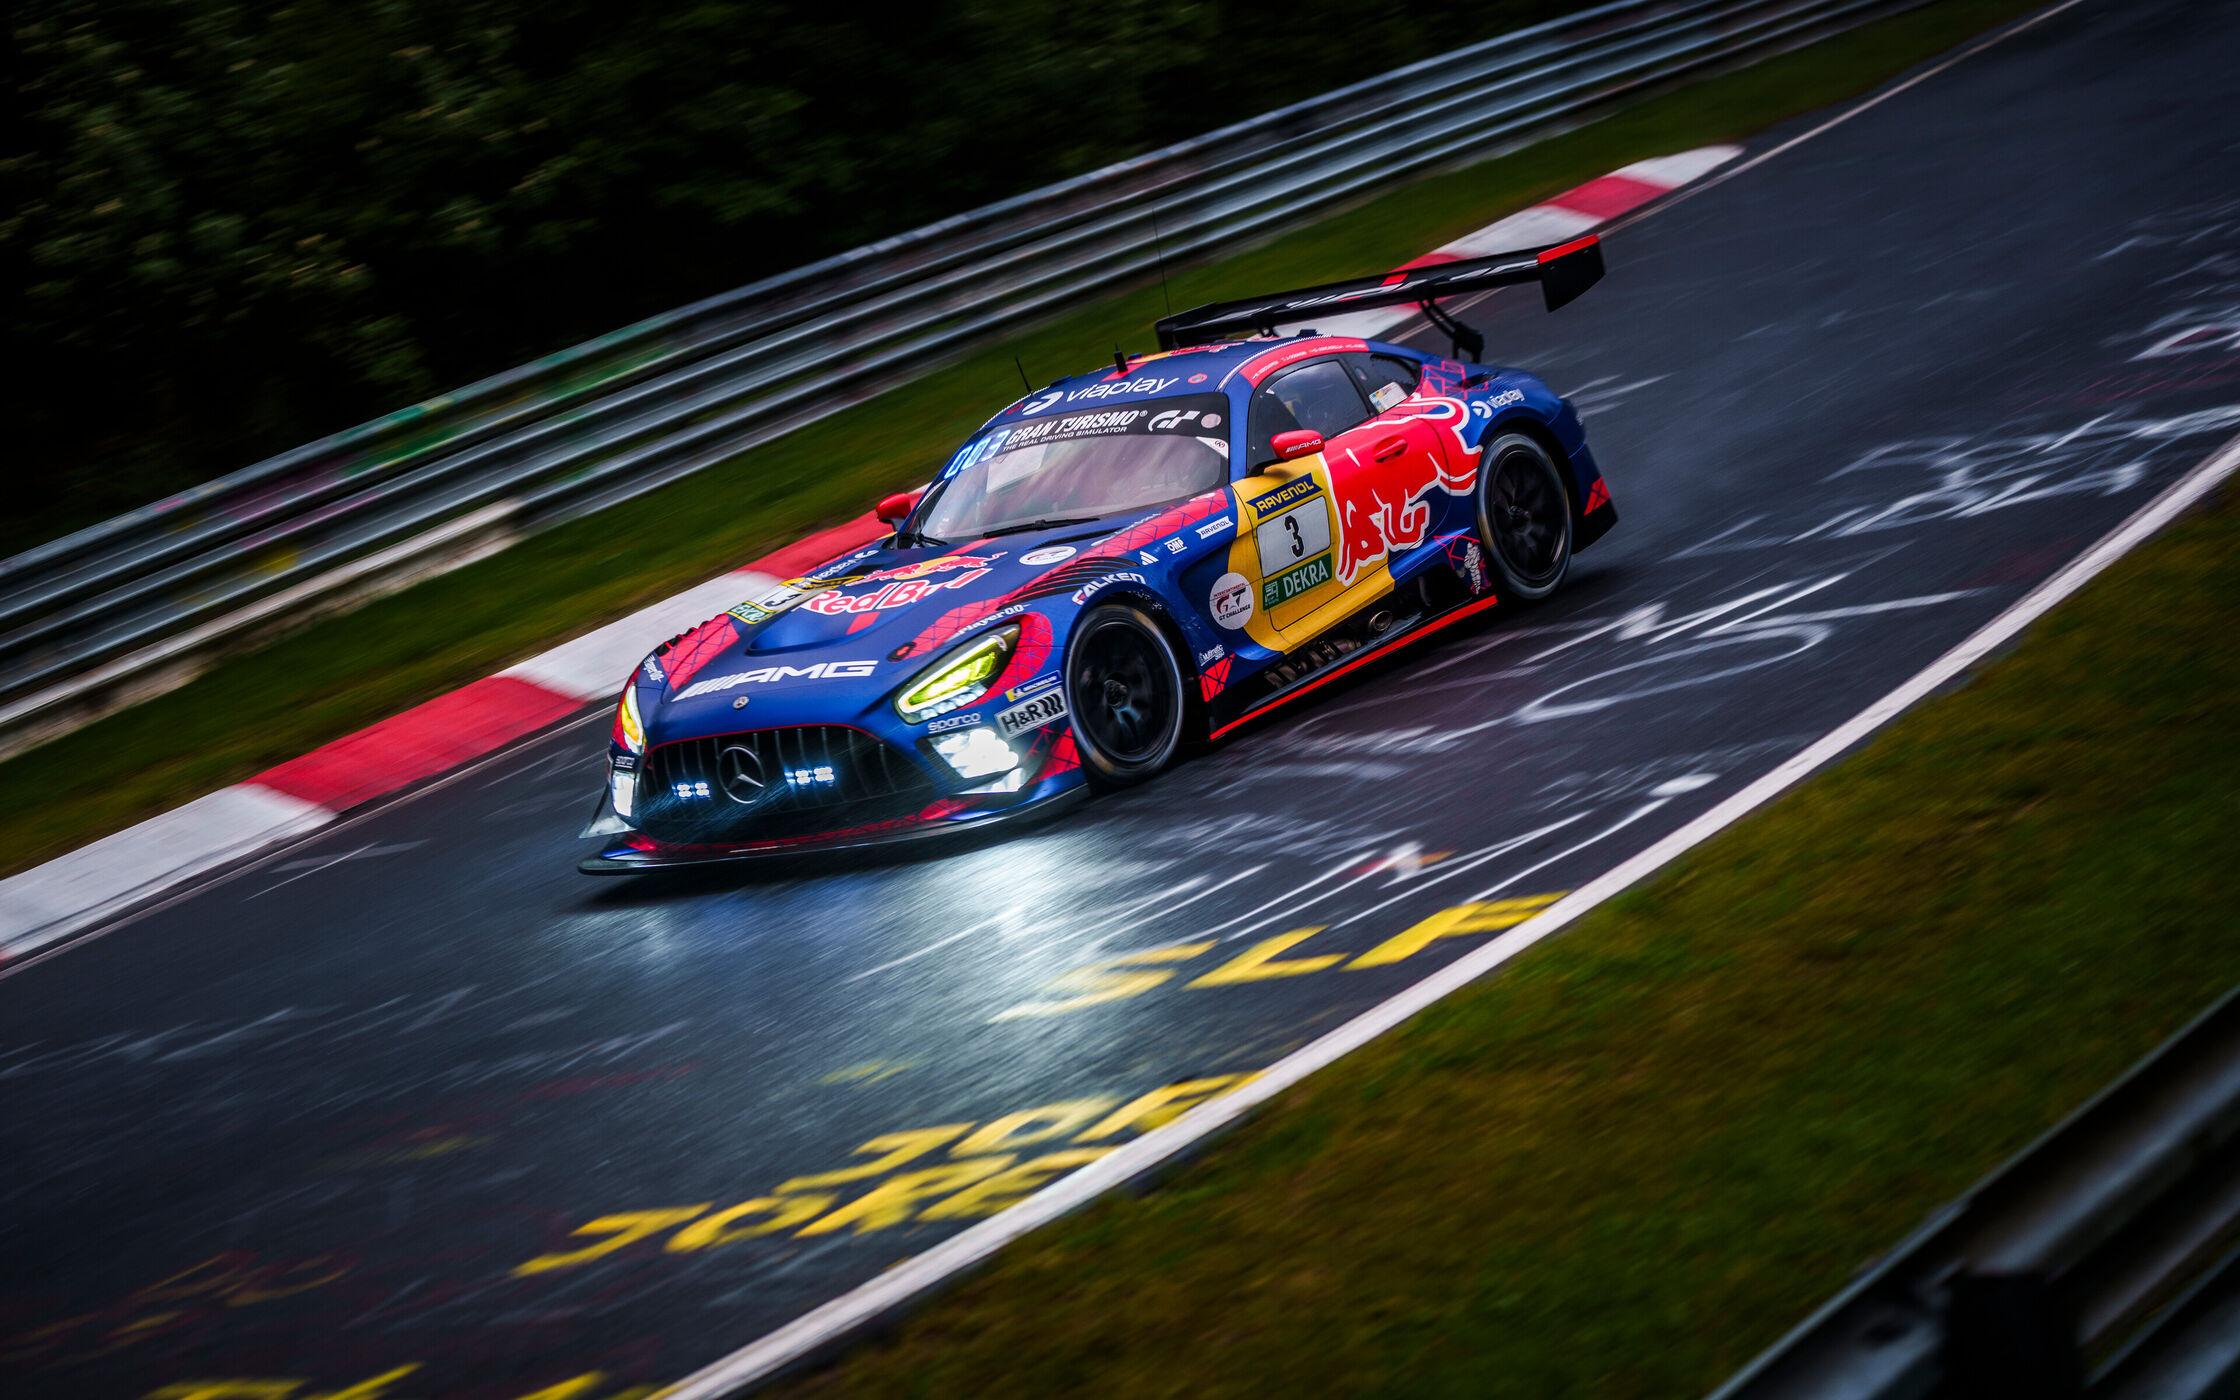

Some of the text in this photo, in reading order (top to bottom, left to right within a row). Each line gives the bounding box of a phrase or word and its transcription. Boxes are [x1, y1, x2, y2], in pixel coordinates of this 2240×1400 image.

[1066, 377, 1180, 403] viaplay
[1003, 425, 1128, 453] THE REAL DRIVING SIMULATOR
[1005, 420, 1058, 446] GRAN
[1256, 481, 1315, 512] RAVENOL
[1200, 519, 1231, 537] RAVENOL
[1284, 504, 1305, 558] 3
[1166, 538, 1185, 552] OMP
[1071, 572, 1147, 606] FALKEN
[1282, 560, 1329, 597] DEKRA
[801, 582, 900, 615] Red
[1226, 603, 1251, 619] CHALLENGE
[927, 712, 981, 732] sparco
[1001, 702, 1043, 733] H&R
